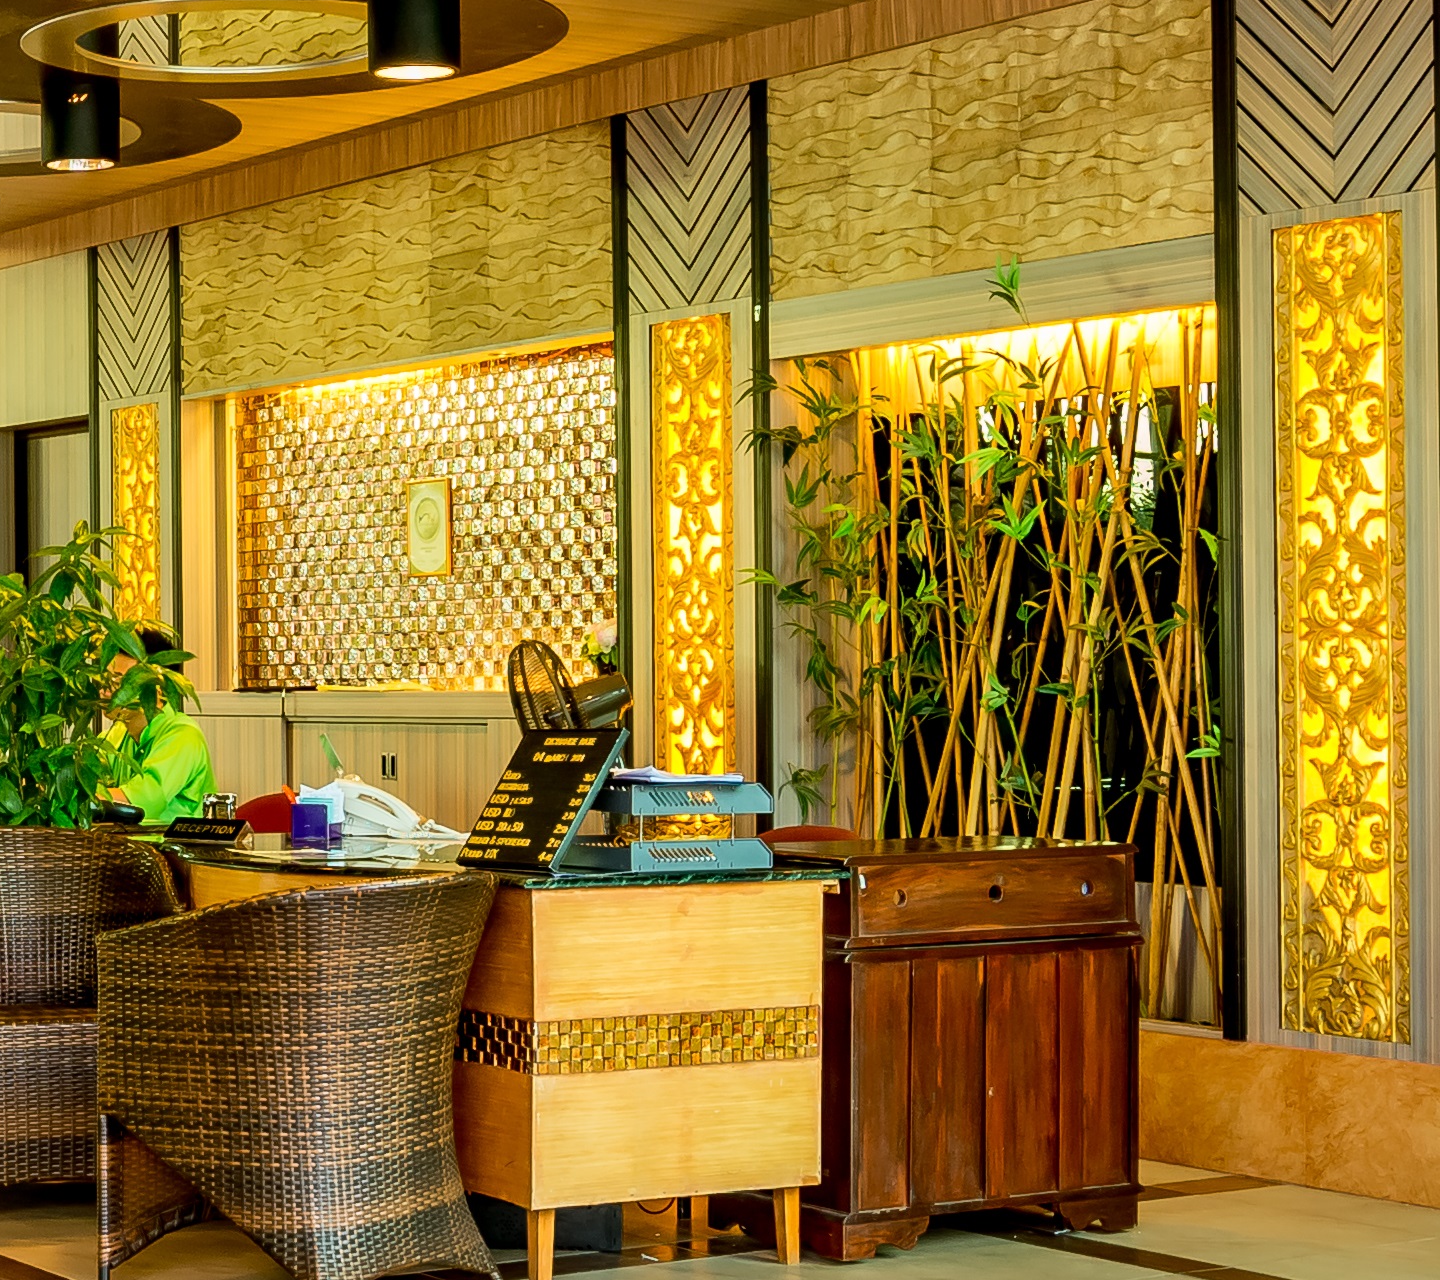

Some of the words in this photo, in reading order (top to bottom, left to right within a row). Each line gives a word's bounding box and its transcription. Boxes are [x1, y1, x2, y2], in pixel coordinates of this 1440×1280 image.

[490, 794, 509, 804] USD
[483, 808, 501, 817] USD
[174, 824, 236, 834] RECEPTION
[476, 821, 494, 830] USD
